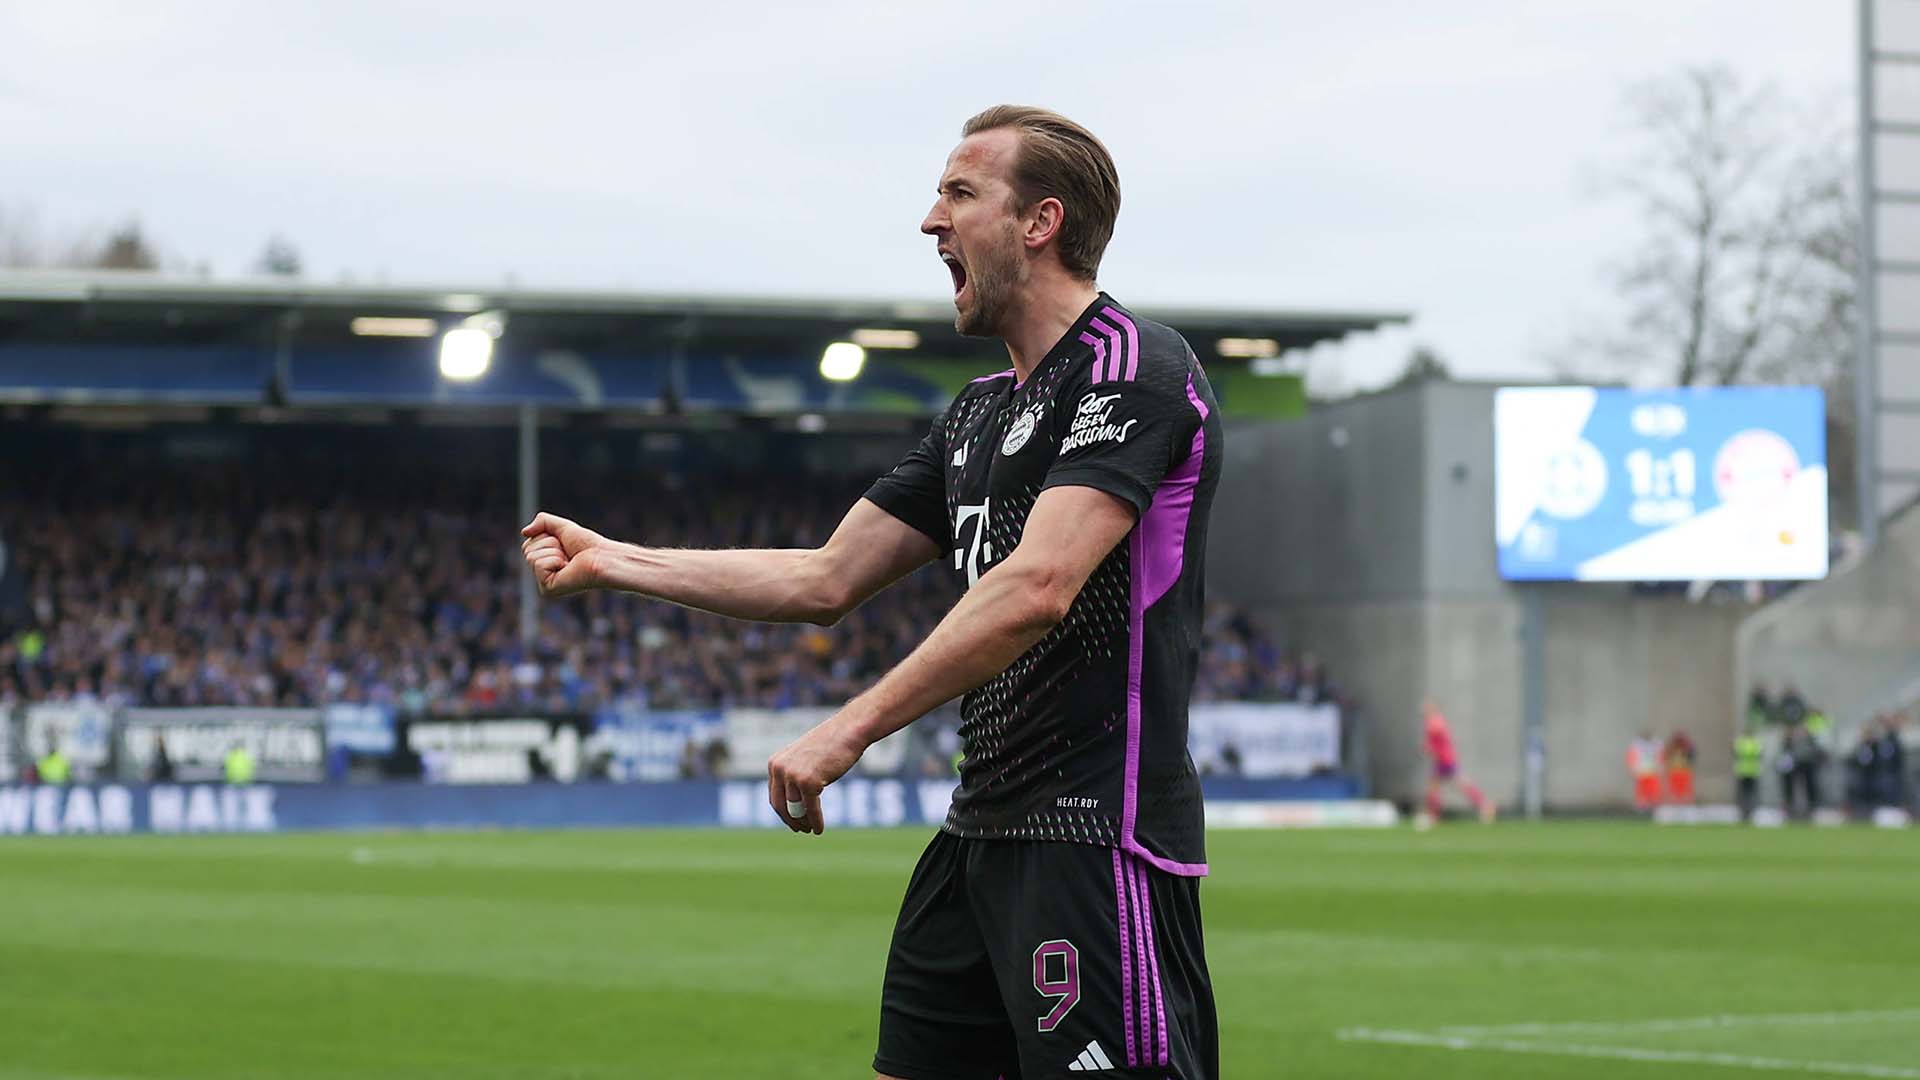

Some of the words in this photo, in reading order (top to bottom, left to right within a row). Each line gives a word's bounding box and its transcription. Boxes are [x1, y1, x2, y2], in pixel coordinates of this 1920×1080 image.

[1076, 392, 1121, 417] ROT
[1071, 405, 1113, 433] GEGEN
[1626, 448, 1696, 497] 1:1
[1056, 796, 1099, 809] HEAT.RDY
[1033, 939, 1081, 1032] 9
